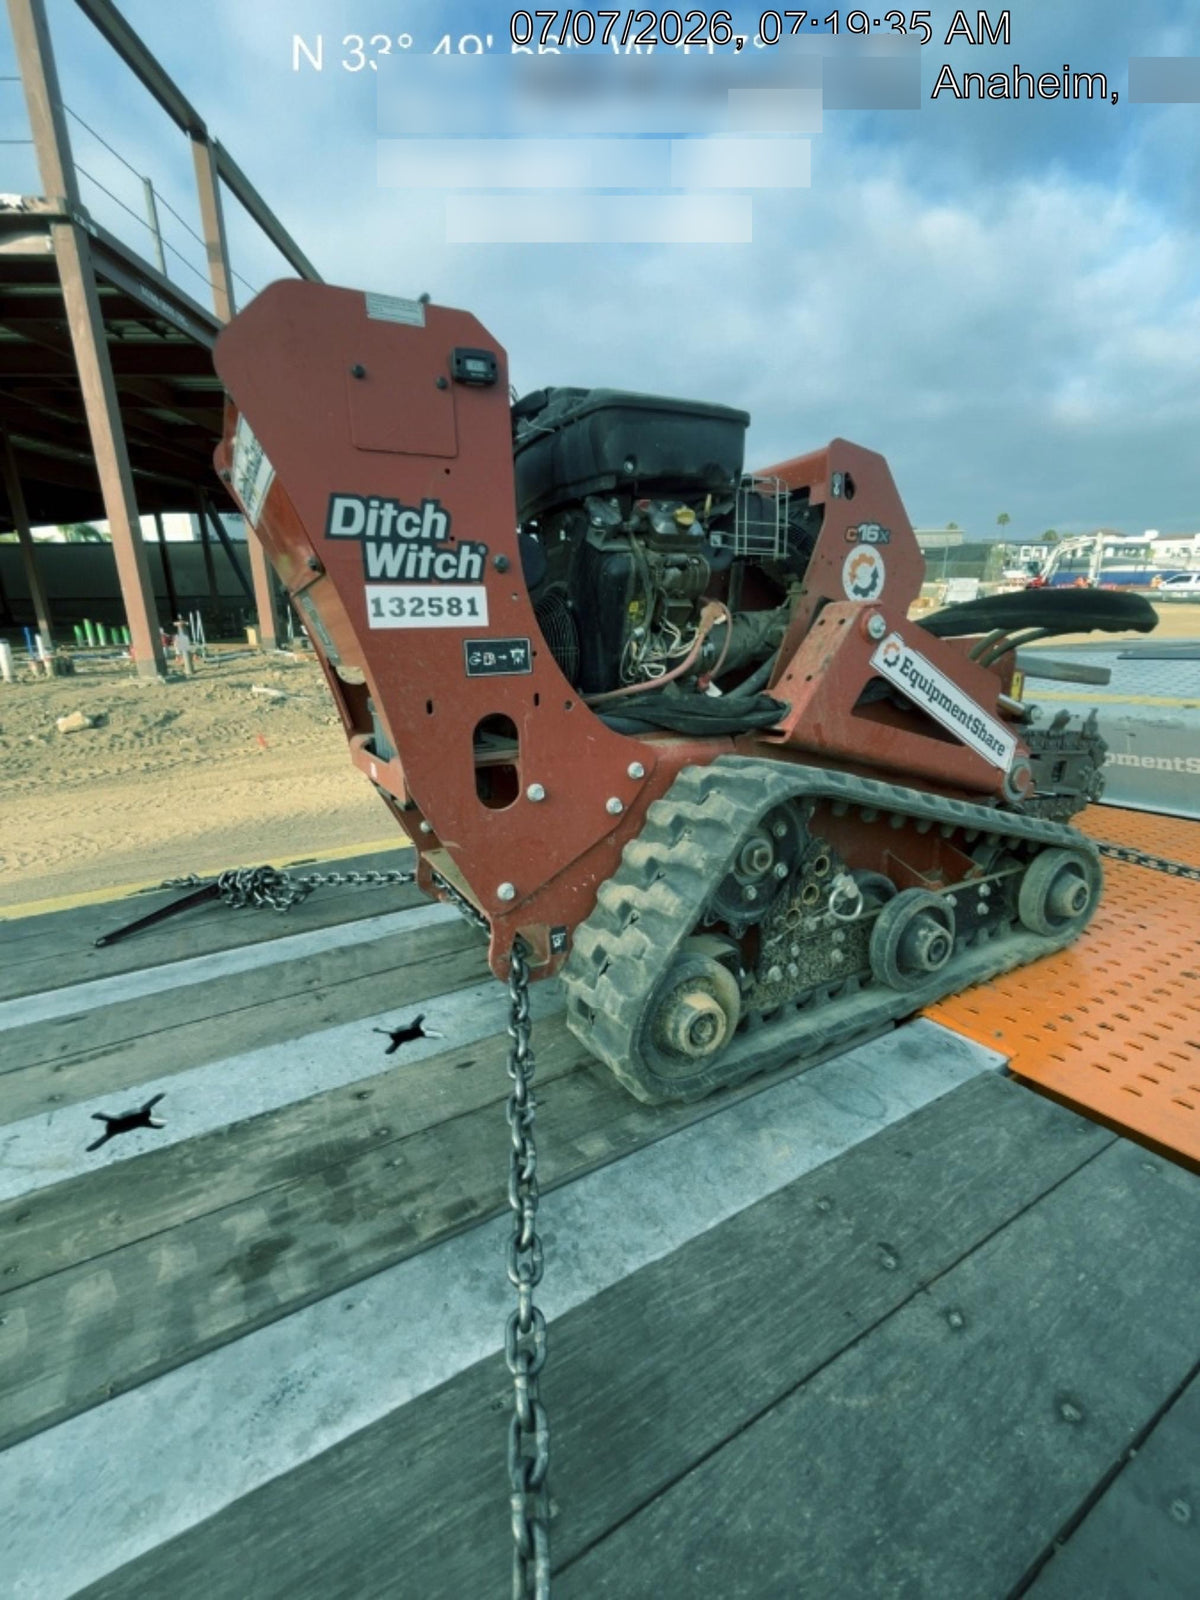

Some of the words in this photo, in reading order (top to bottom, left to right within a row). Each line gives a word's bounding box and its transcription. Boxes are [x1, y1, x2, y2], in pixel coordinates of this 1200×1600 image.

[328, 496, 449, 540] Ditch
[365, 541, 483, 580] Witch
[370, 596, 479, 618] 132581
[899, 655, 1006, 757] EquipmentShare
